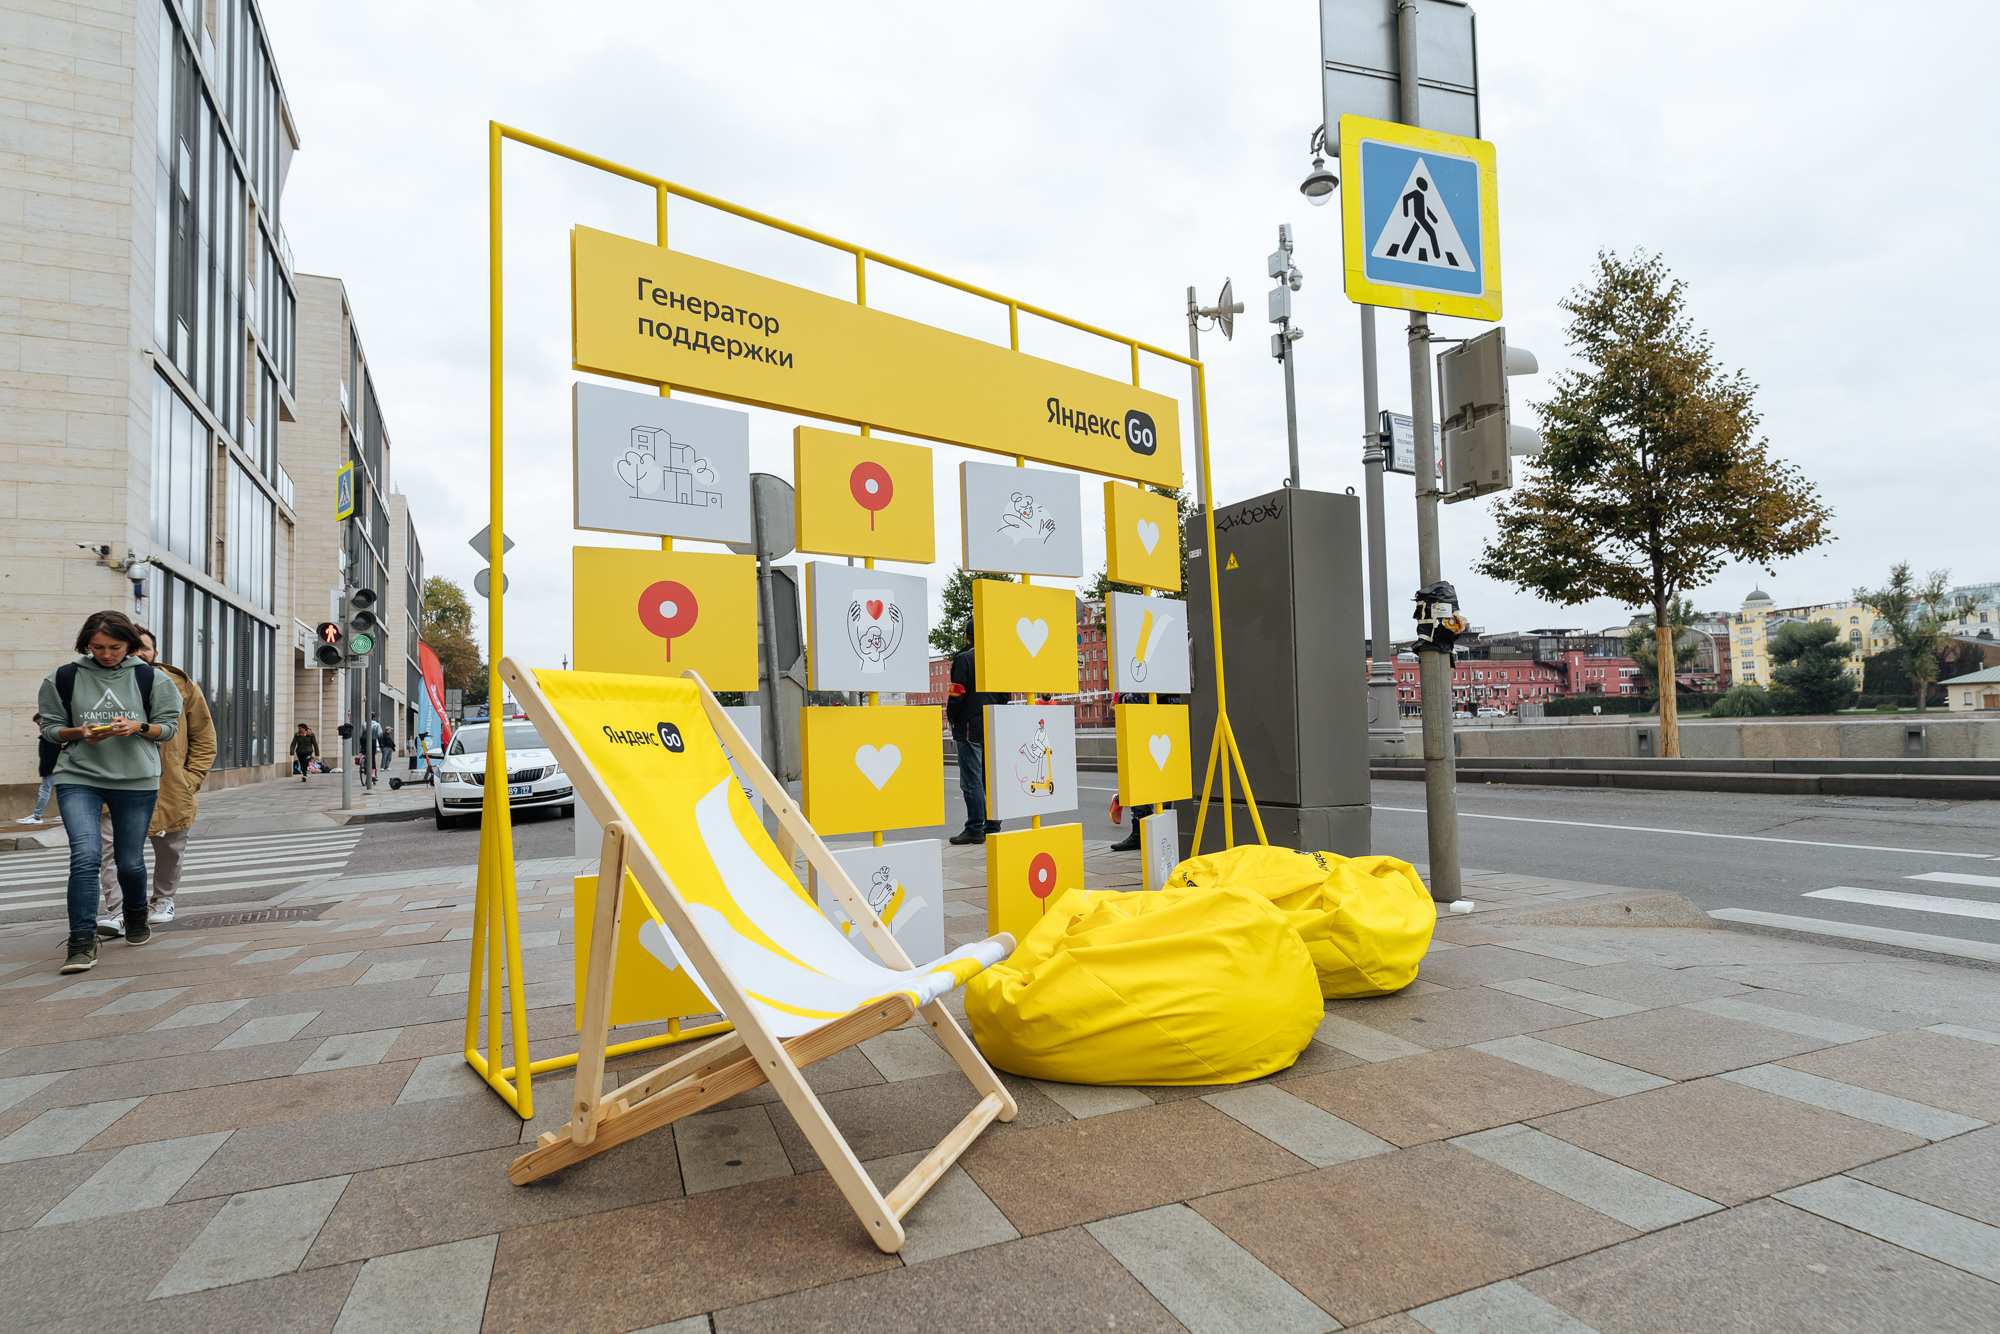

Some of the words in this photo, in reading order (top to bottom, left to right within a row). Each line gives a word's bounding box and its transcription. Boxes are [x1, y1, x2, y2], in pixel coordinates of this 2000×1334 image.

[638, 276, 780, 337] Генератор
[638, 317, 794, 369] поддержки
[1046, 397, 1121, 440] Яндекс
[1127, 416, 1154, 449] Go
[83, 711, 136, 720] KAMCHATKA
[602, 725, 659, 747] Яндекс
[660, 726, 682, 748] Go
